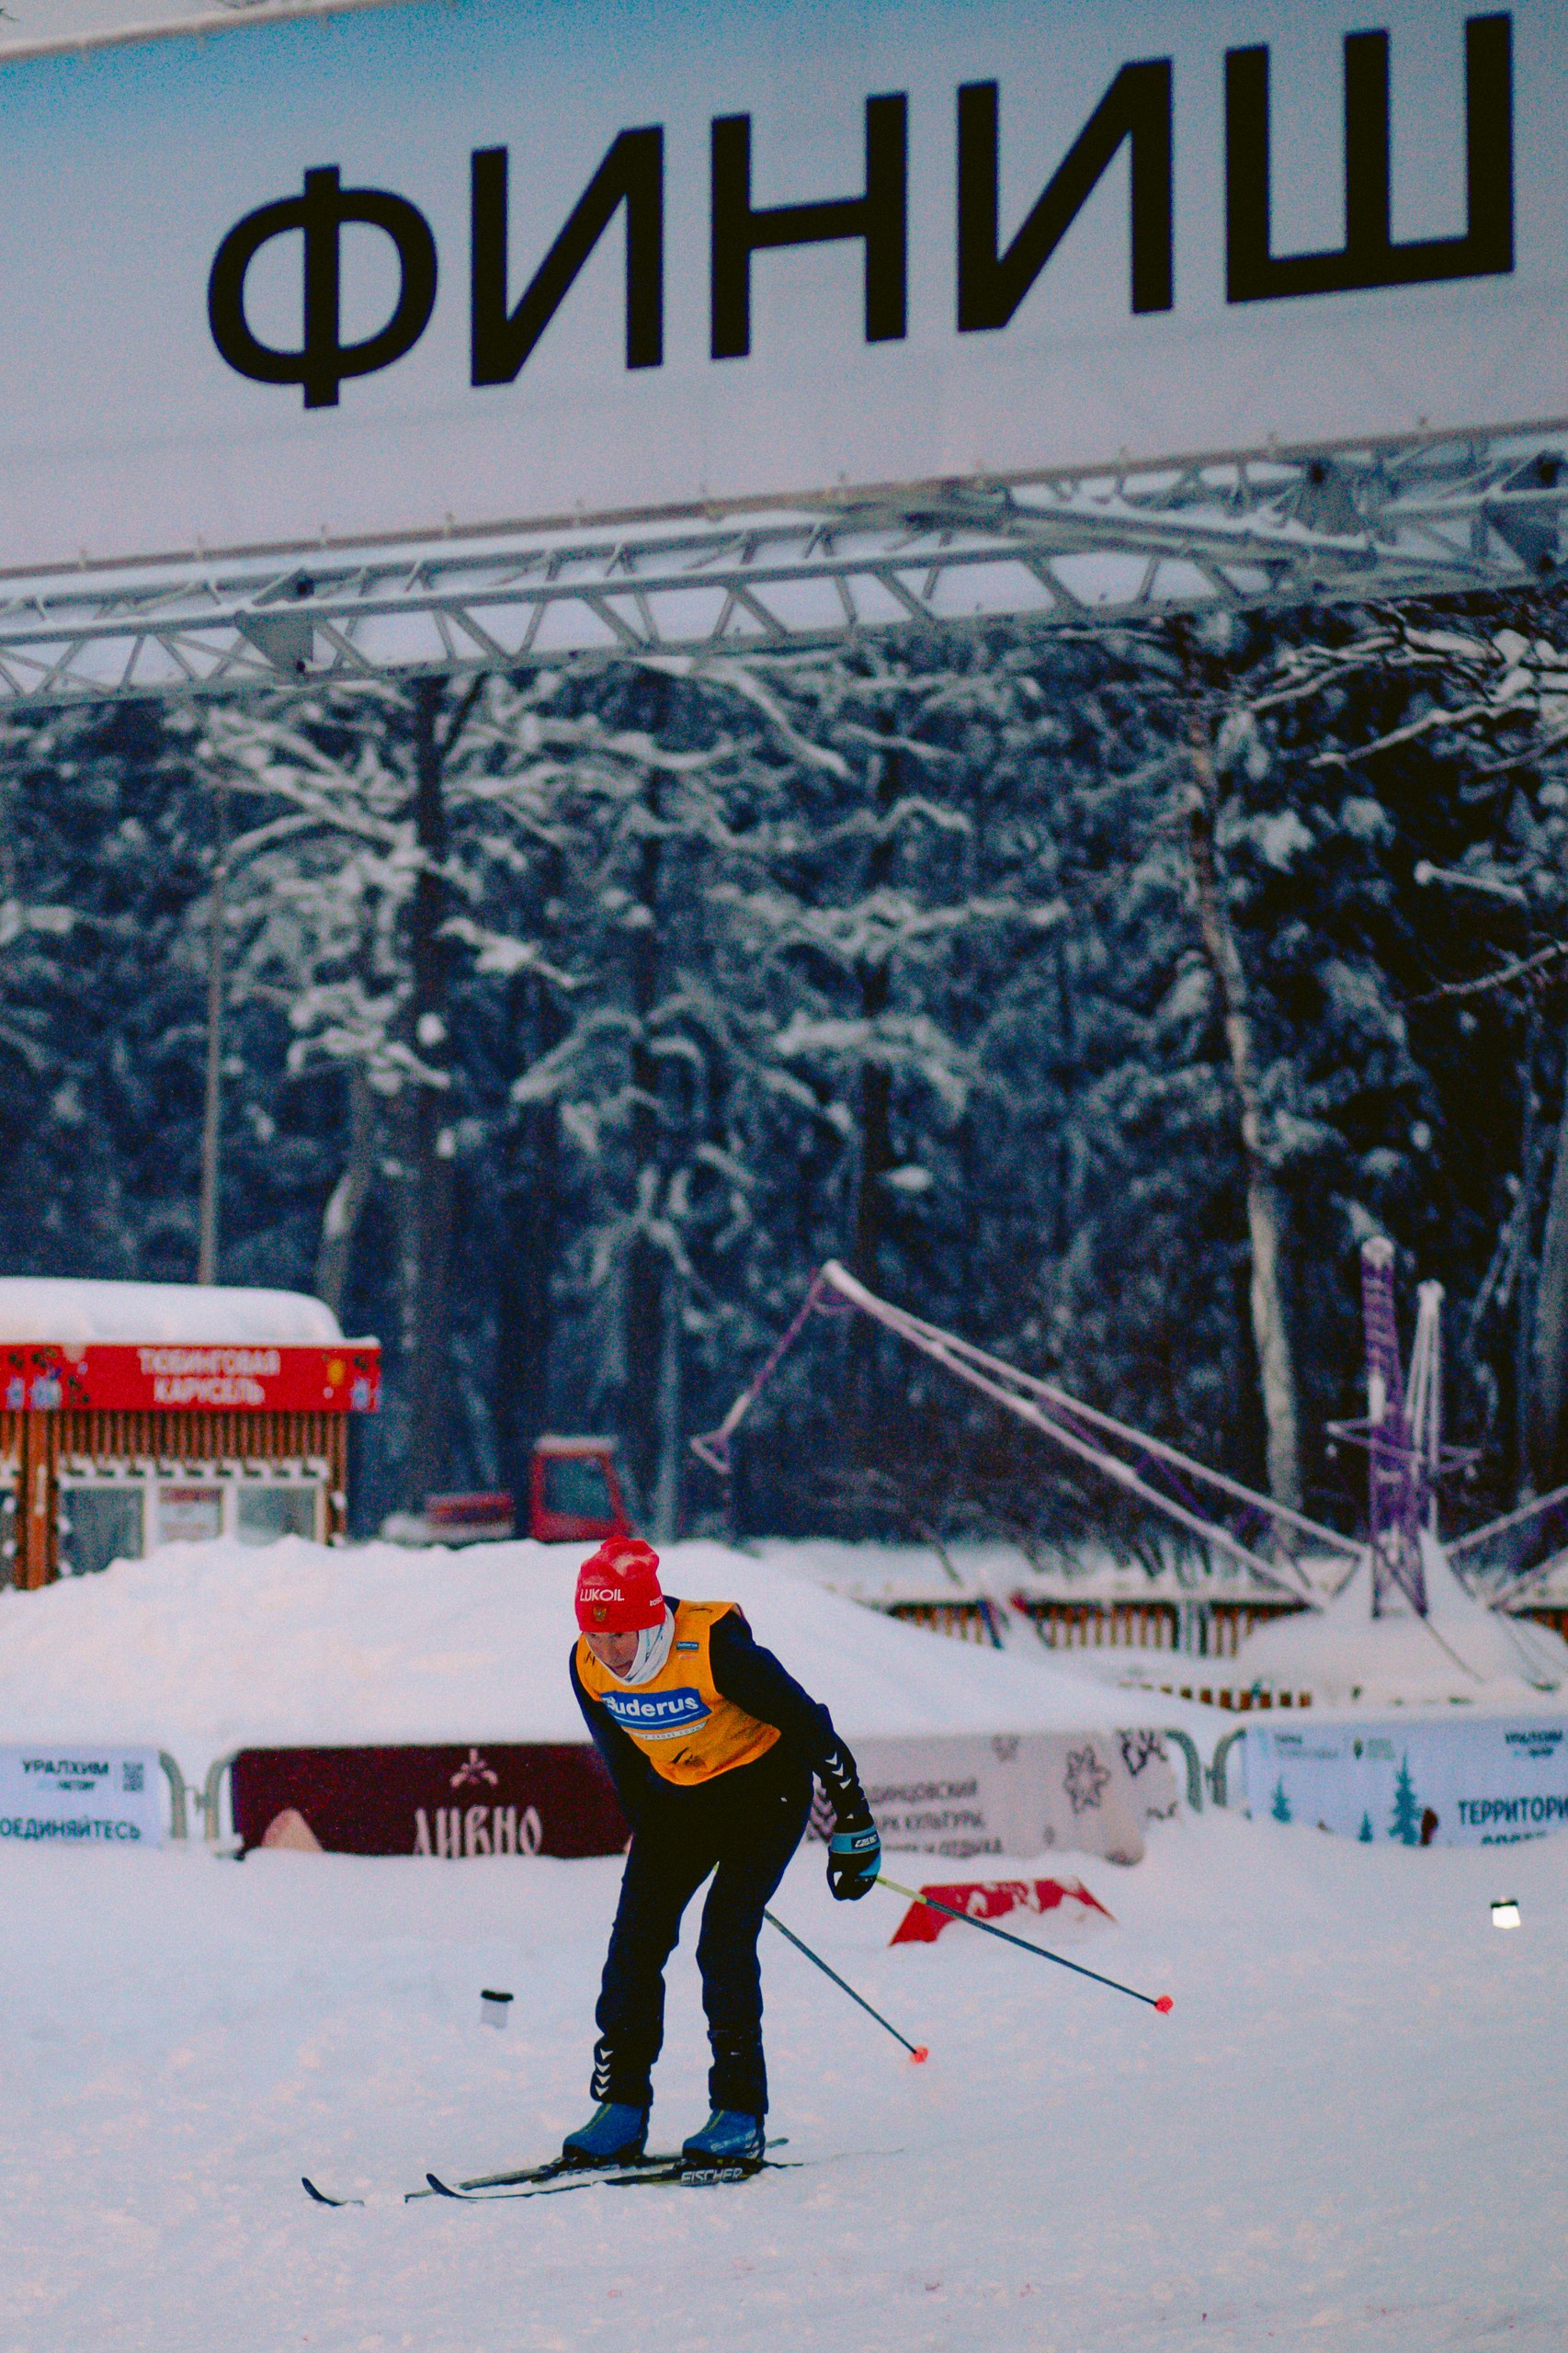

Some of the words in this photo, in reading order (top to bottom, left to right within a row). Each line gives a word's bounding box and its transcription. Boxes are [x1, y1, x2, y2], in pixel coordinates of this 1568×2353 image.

[208, 11, 1515, 408] ФИНИШ
[138, 1348, 280, 1377] ТЮБИНГОВАЯ
[153, 1378, 266, 1405] КАРУСЕЛЬ
[579, 1588, 625, 1602] LUKOIL
[602, 1697, 699, 1717] Buderus
[23, 1758, 109, 1776] УРАЛХИМ
[867, 1777, 978, 1804] ДИНЦОВСКИЙ
[680, 2167, 743, 2185] FISCHER
